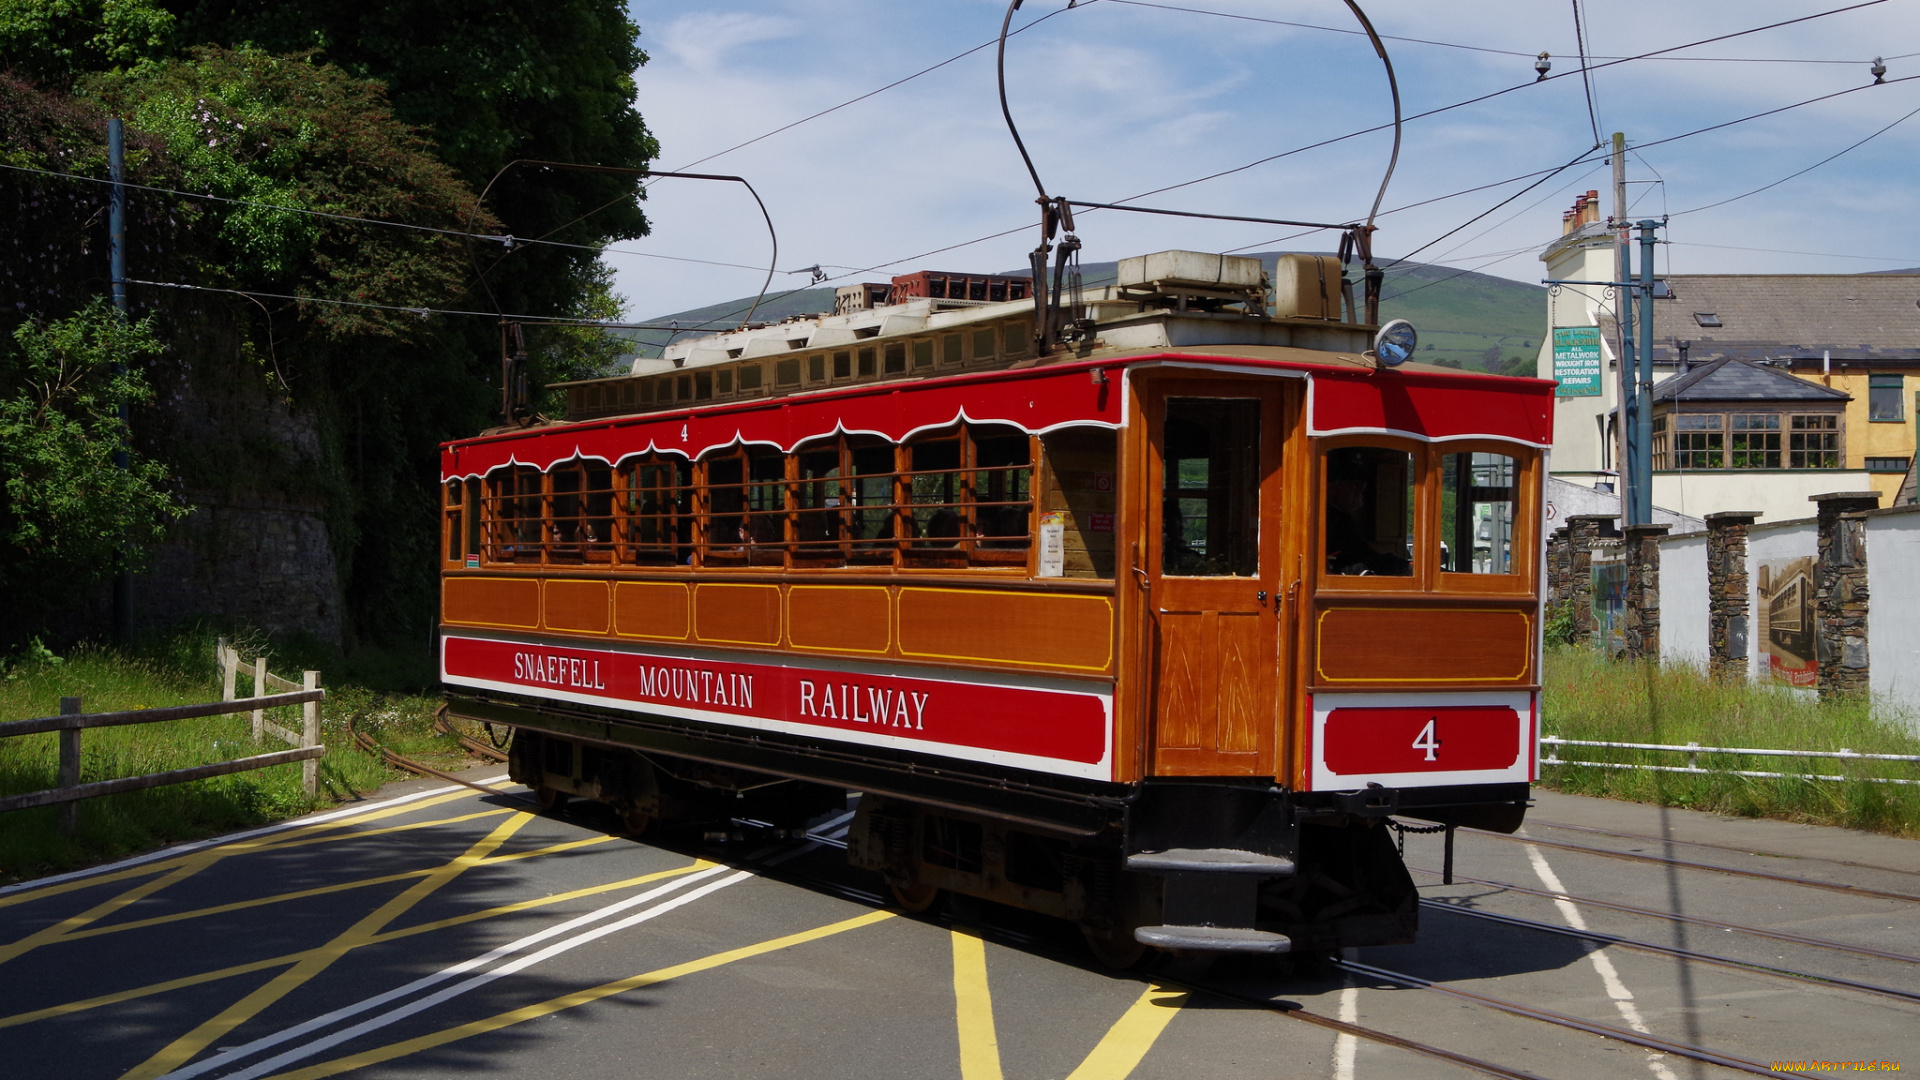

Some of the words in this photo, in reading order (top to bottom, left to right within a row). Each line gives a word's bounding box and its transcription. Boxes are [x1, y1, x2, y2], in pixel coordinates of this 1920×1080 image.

[1556, 330, 1570, 338] THE
[1555, 351, 1599, 359] METALWORK
[1555, 368, 1600, 376] RESTORATION
[1562, 377, 1591, 385] REPAIRS
[681, 423, 688, 442] 4
[514, 652, 605, 690] SNAEFELL
[640, 665, 753, 709] MOUNTAIN
[800, 680, 929, 730] RAILWAY
[1412, 719, 1440, 761] 4
